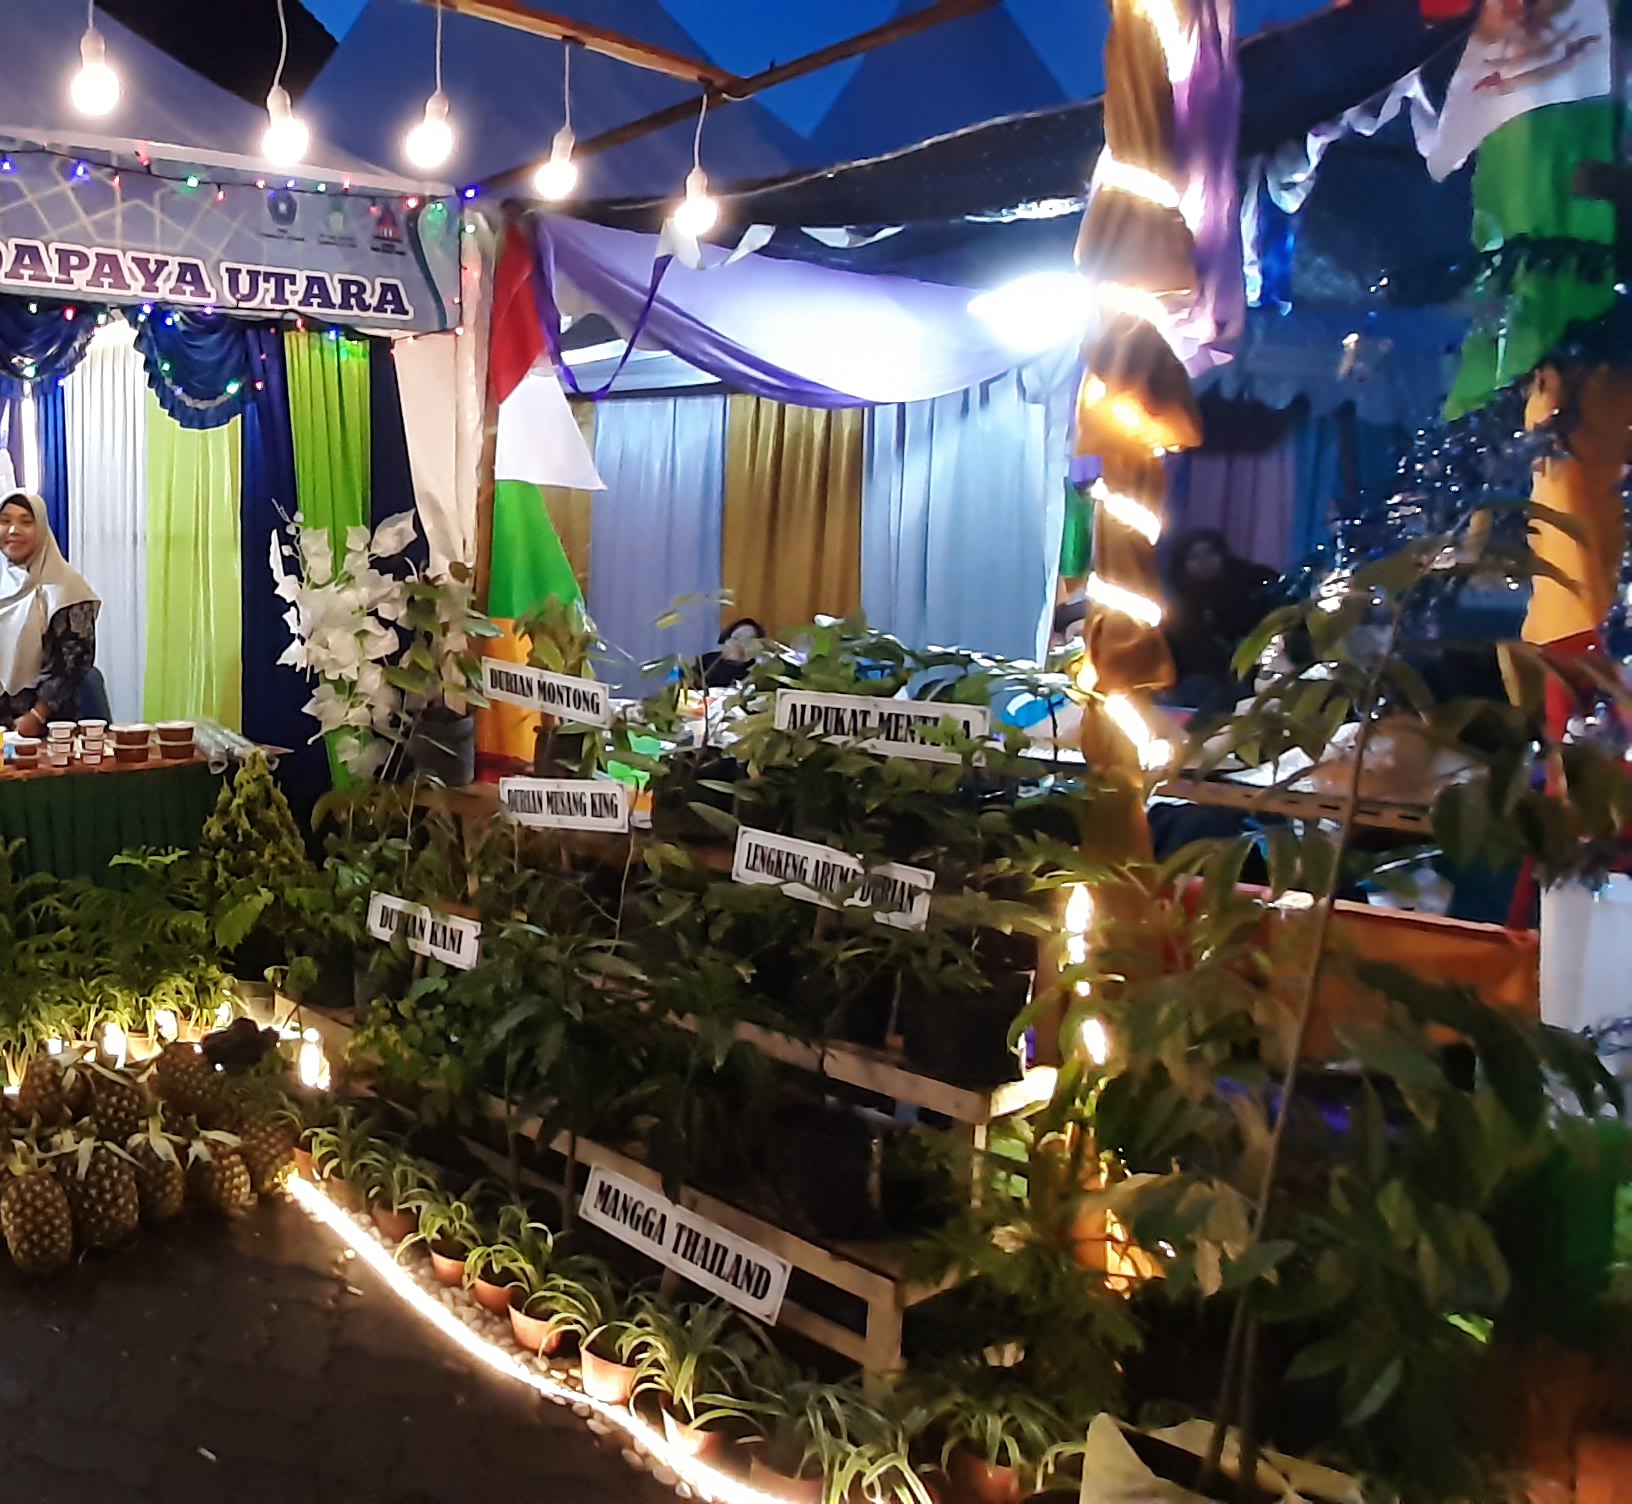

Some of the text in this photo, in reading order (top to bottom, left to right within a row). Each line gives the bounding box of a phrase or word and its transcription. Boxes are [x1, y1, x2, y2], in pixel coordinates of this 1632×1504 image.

[224, 267, 410, 316] UTARA
[489, 668, 601, 715] DURIAN MONTONG
[788, 702, 972, 747] ALPUKAT MENTEA
[507, 788, 618, 819] DURIAN MUSANG KING
[744, 842, 809, 882] LENGKENG
[379, 905, 464, 955] DUIAN KANI
[594, 1181, 772, 1301] MANGGA THAILAND
